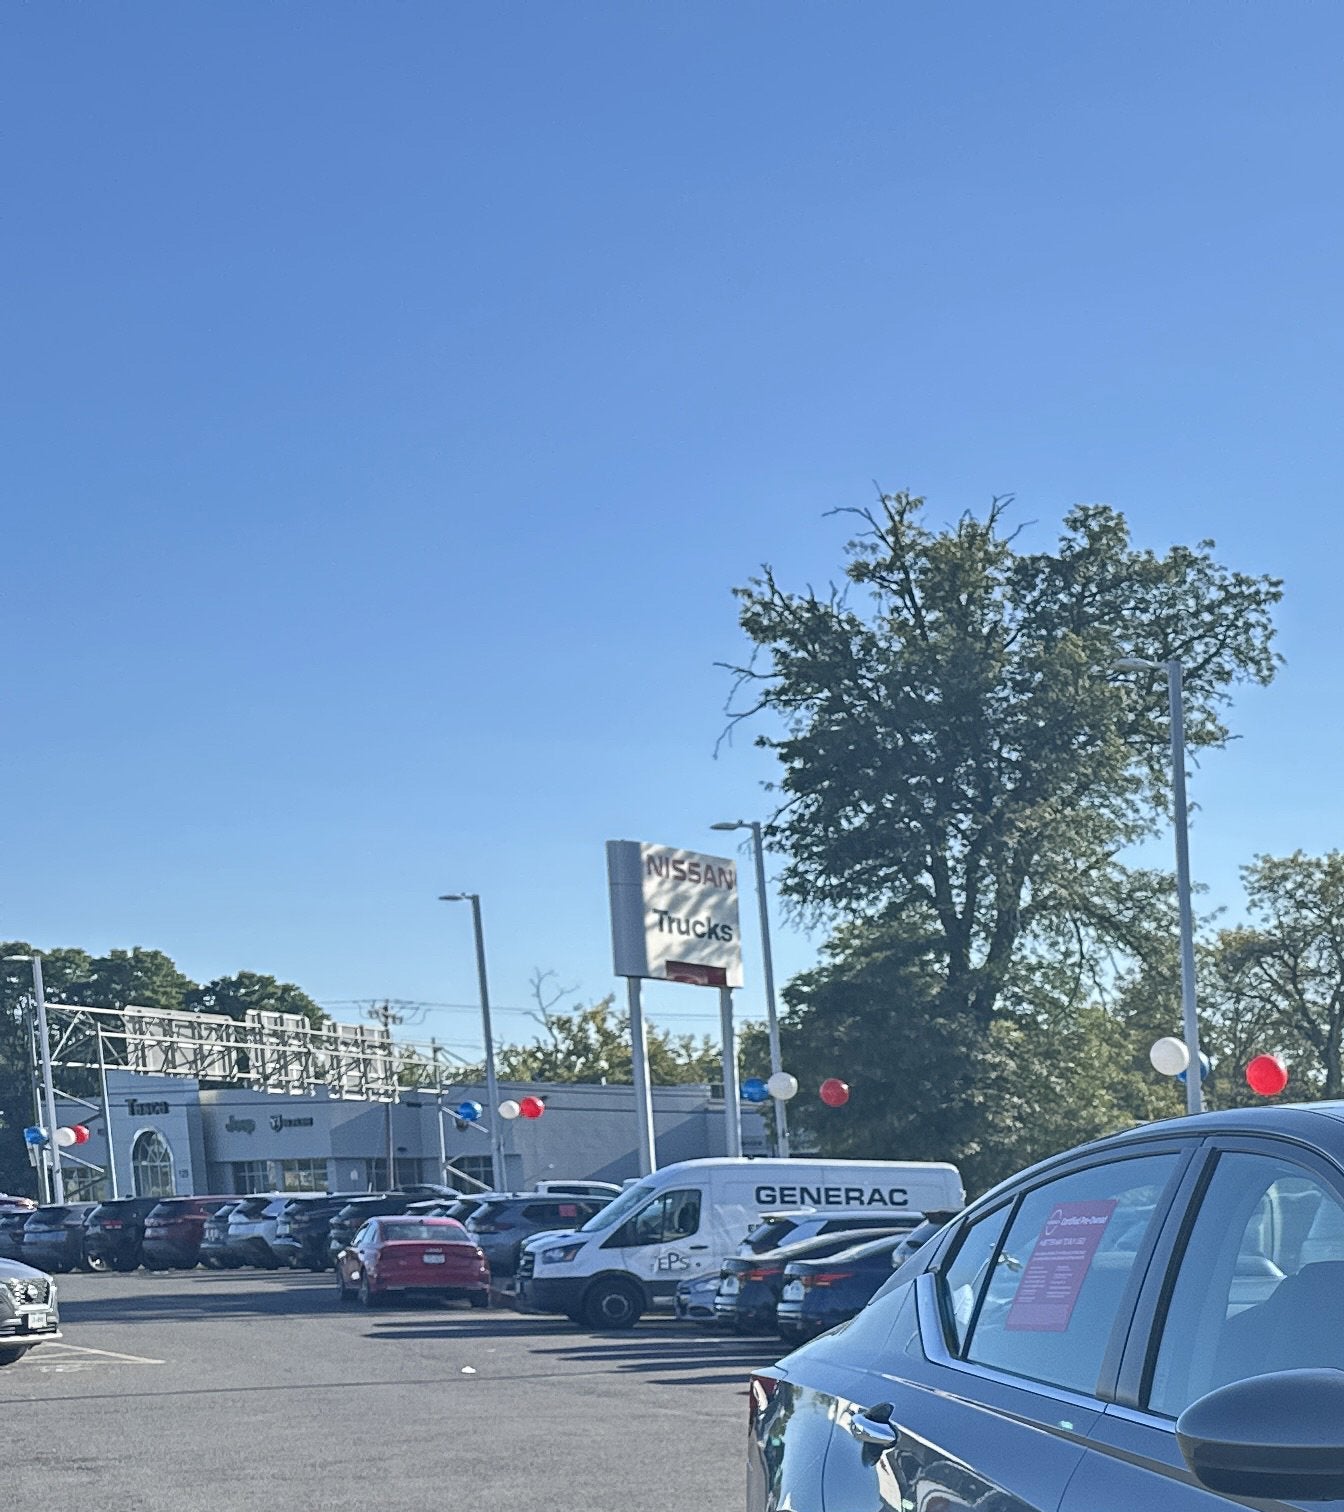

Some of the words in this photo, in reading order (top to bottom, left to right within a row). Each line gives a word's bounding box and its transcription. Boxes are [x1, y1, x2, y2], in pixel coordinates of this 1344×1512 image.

[645, 854, 734, 891] NISSAN
[651, 908, 734, 942] Trucks
[754, 1185, 909, 1208] GENERAC
